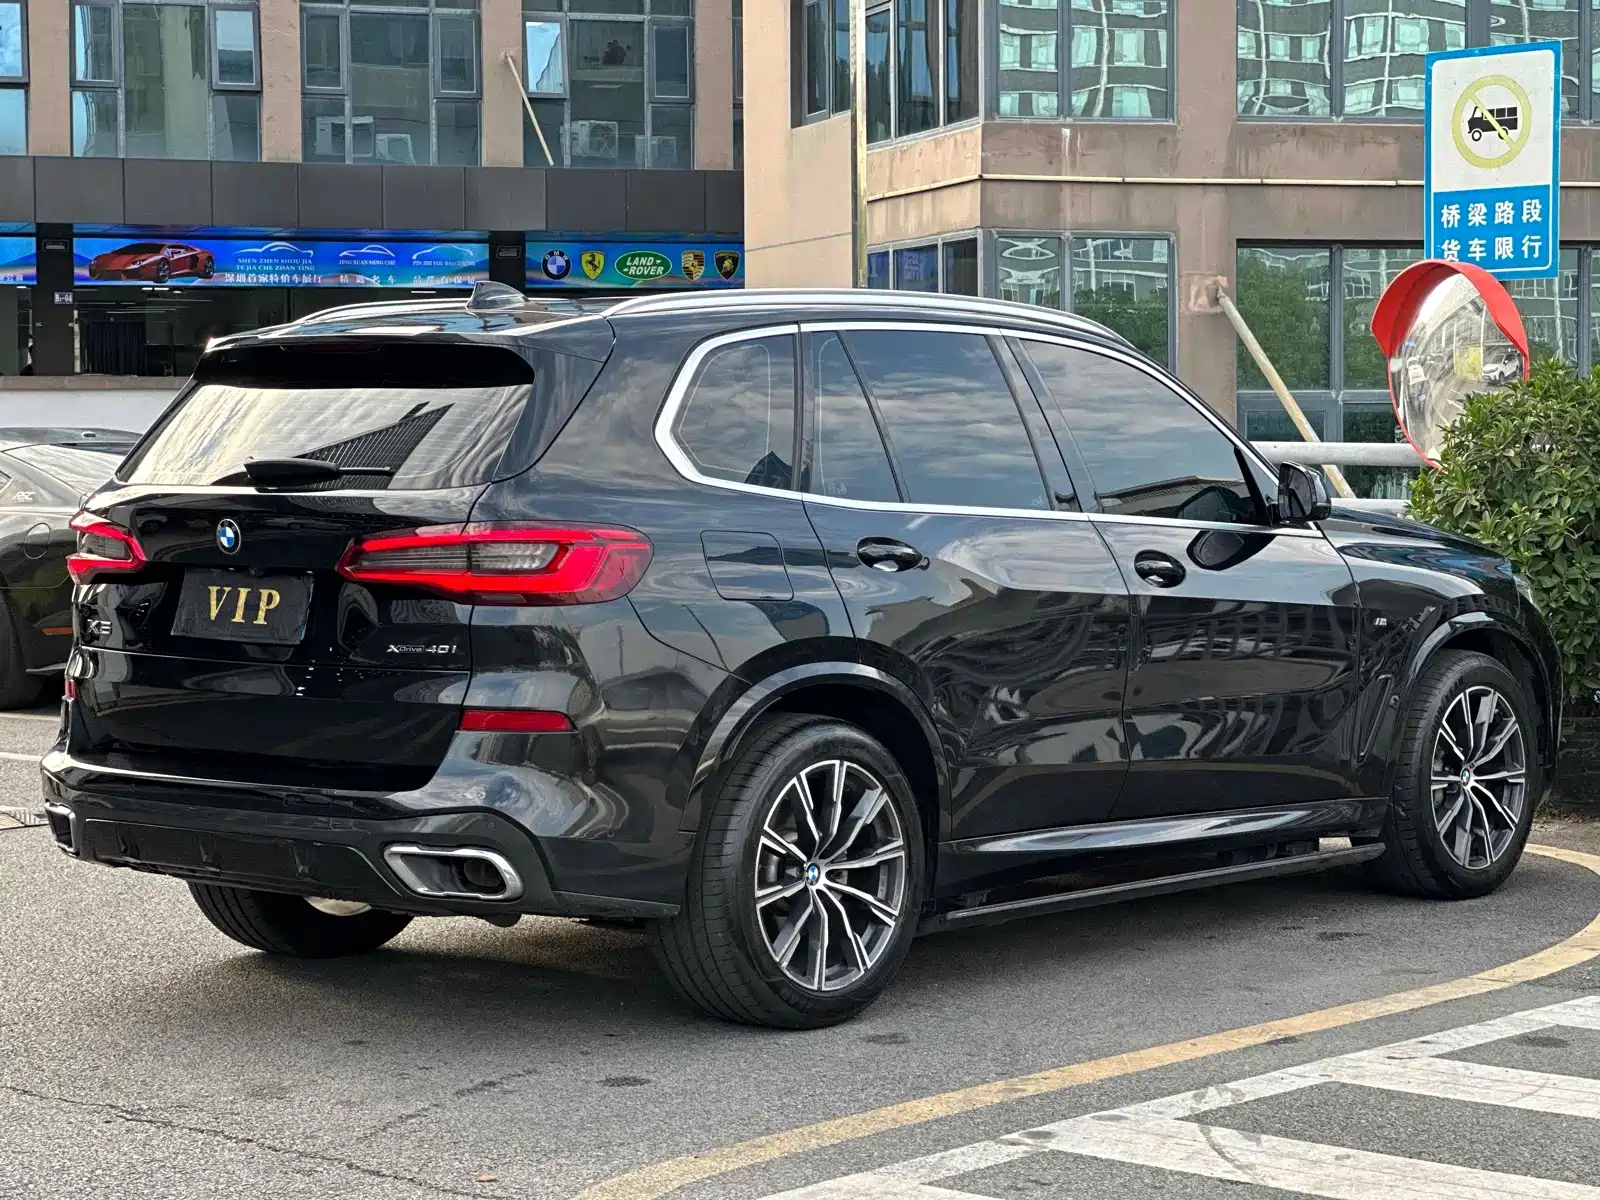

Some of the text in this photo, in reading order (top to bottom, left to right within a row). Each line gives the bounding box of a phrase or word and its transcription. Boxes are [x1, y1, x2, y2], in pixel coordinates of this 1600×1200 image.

[1441, 199, 1543, 228] 桥梁路段
[626, 256, 655, 266] LAND
[1441, 234, 1543, 262] 货车限行
[628, 266, 665, 275] ROVER
[207, 585, 281, 625] VIP
